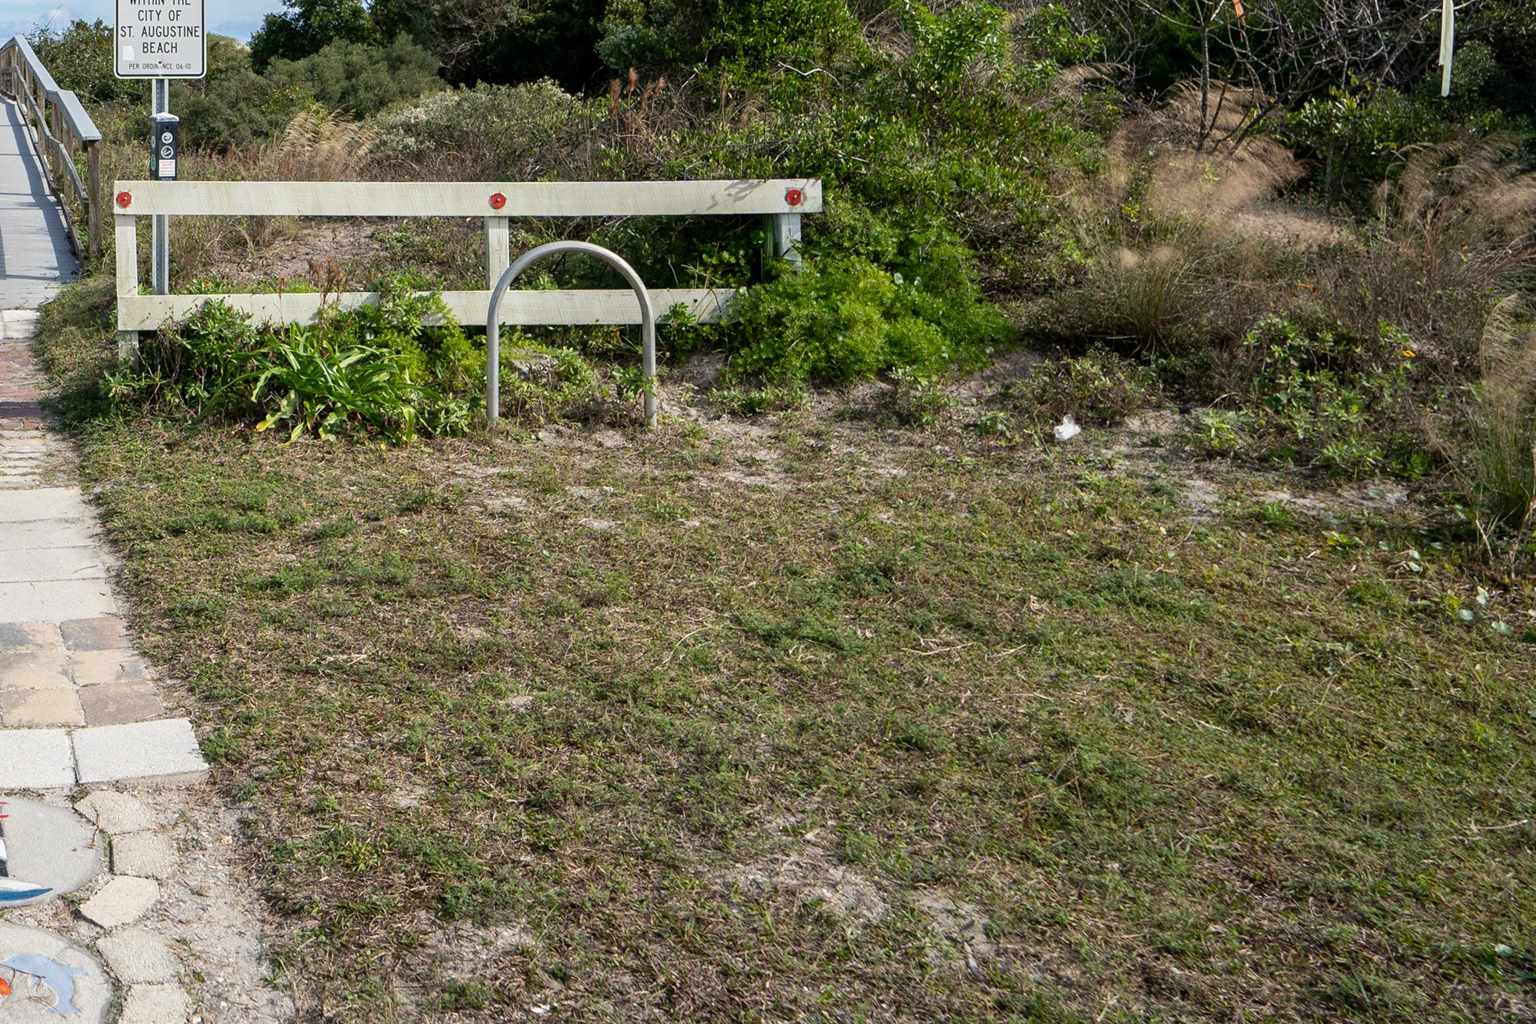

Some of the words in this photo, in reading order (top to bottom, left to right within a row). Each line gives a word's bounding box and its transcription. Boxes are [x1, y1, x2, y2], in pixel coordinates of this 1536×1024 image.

[137, 9, 162, 22] CITY
[168, 10, 182, 21] OF
[120, 25, 135, 38] ST.
[141, 25, 200, 38] AUGUSTINE
[142, 41, 178, 54] BEACH
